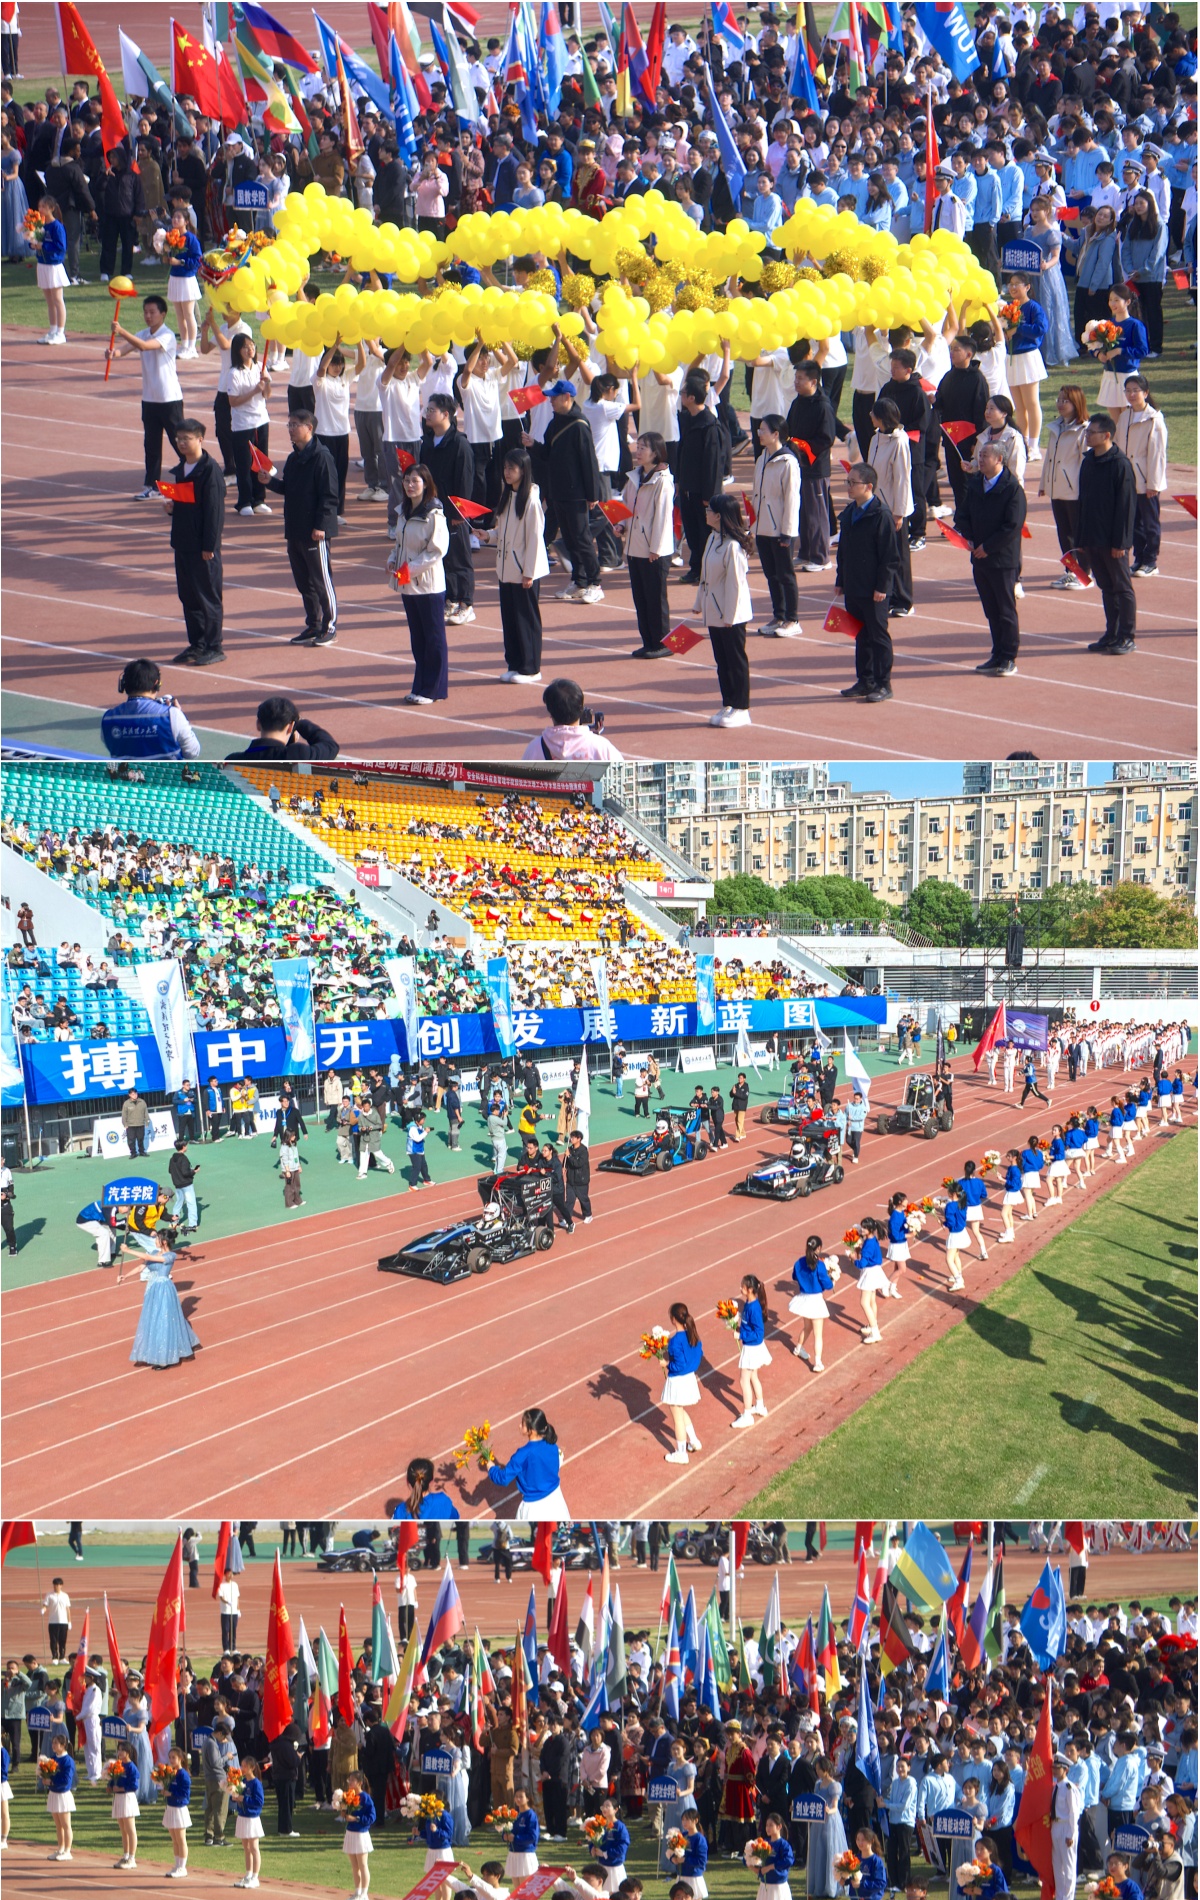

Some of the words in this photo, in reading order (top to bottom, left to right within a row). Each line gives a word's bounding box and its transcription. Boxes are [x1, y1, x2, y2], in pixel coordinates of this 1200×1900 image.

[943, 6, 981, 68] WUT
[237, 189, 267, 206] 国教学院
[686, 1110, 697, 1121] A25
[541, 1179, 550, 1189] 02
[108, 1185, 153, 1202] 汽车学院
[29, 1712, 50, 1728] 航运学院
[104, 1721, 127, 1738] 后勤集团
[425, 1756, 451, 1772] 国教学院
[650, 1784, 676, 1800] 法学社会学院
[795, 1801, 823, 1818] 创业学院
[936, 1816, 971, 1835] 船海能动学院
